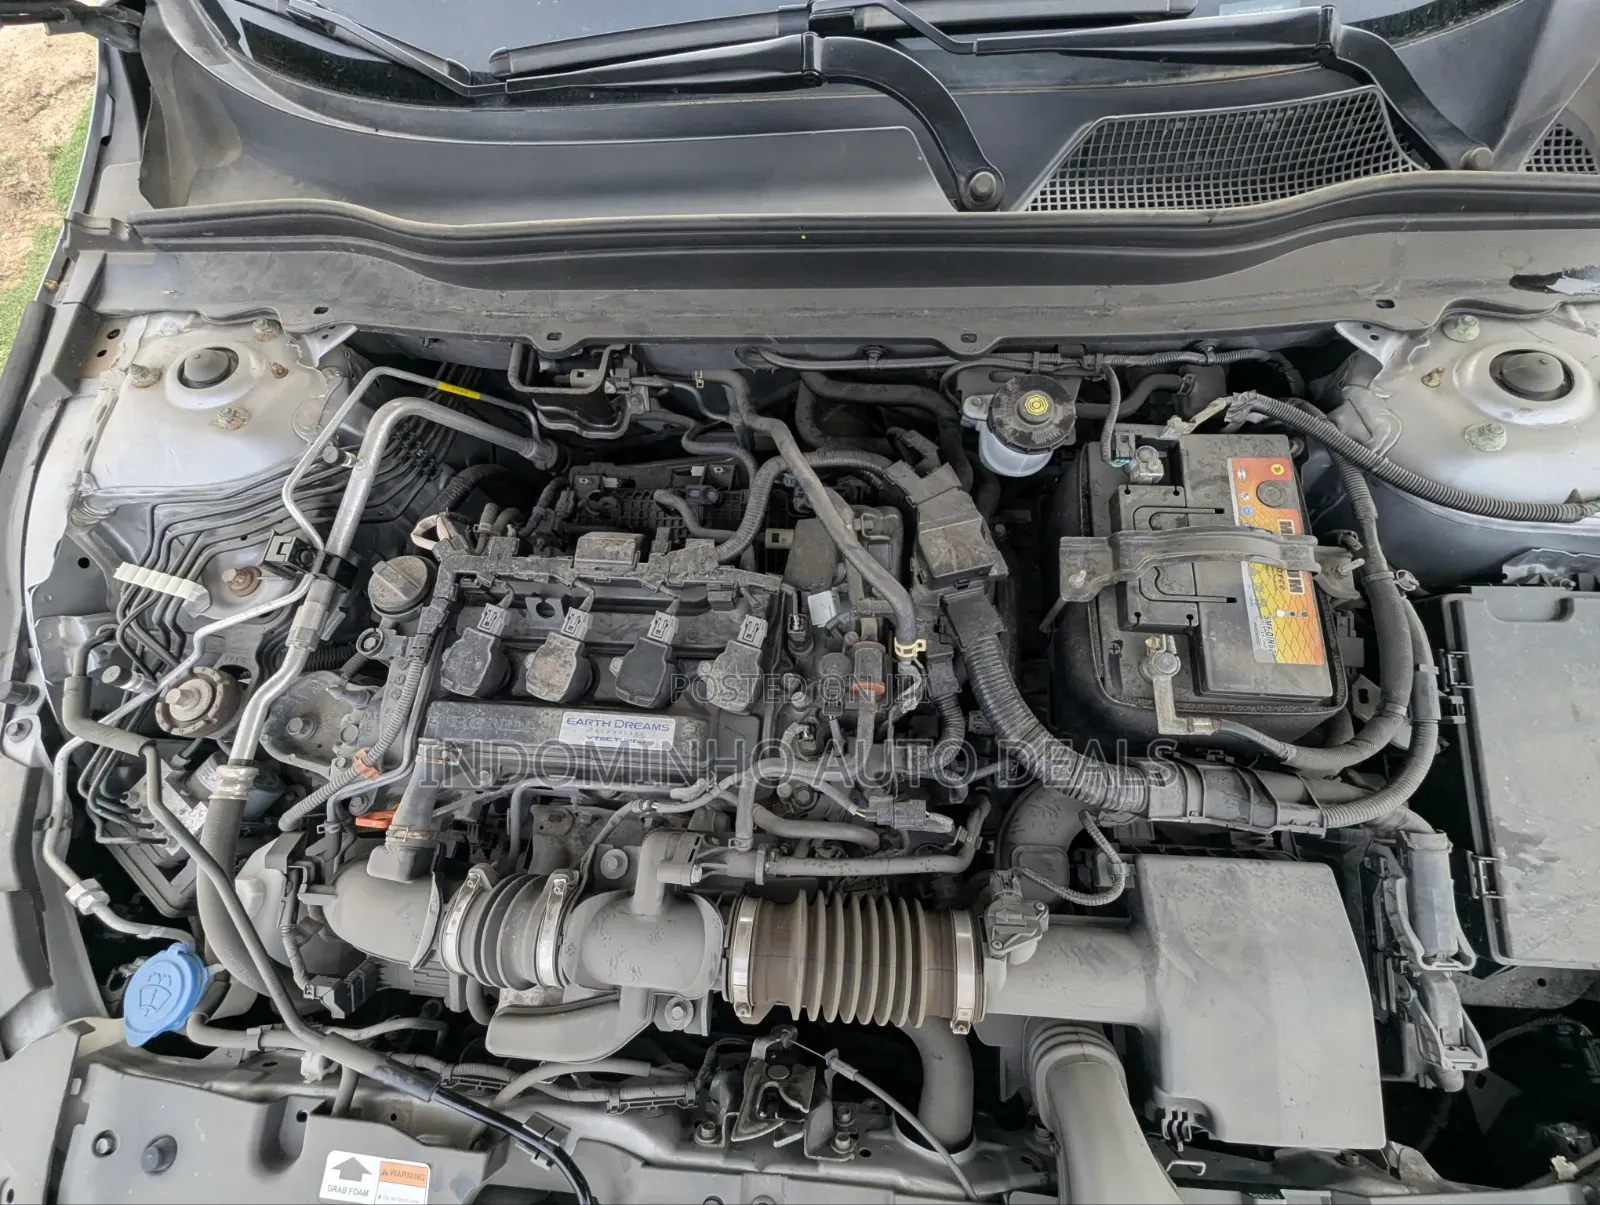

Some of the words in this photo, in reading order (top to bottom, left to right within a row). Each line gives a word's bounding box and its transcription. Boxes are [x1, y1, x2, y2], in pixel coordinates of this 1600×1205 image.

[1276, 567, 1286, 590] orce
[566, 717, 611, 728] EARTH
[614, 719, 670, 732] DREAMS
[389, 1168, 426, 1182] WARNING
[327, 1184, 348, 1195] GRAB
[348, 1187, 370, 1197] FOAM
